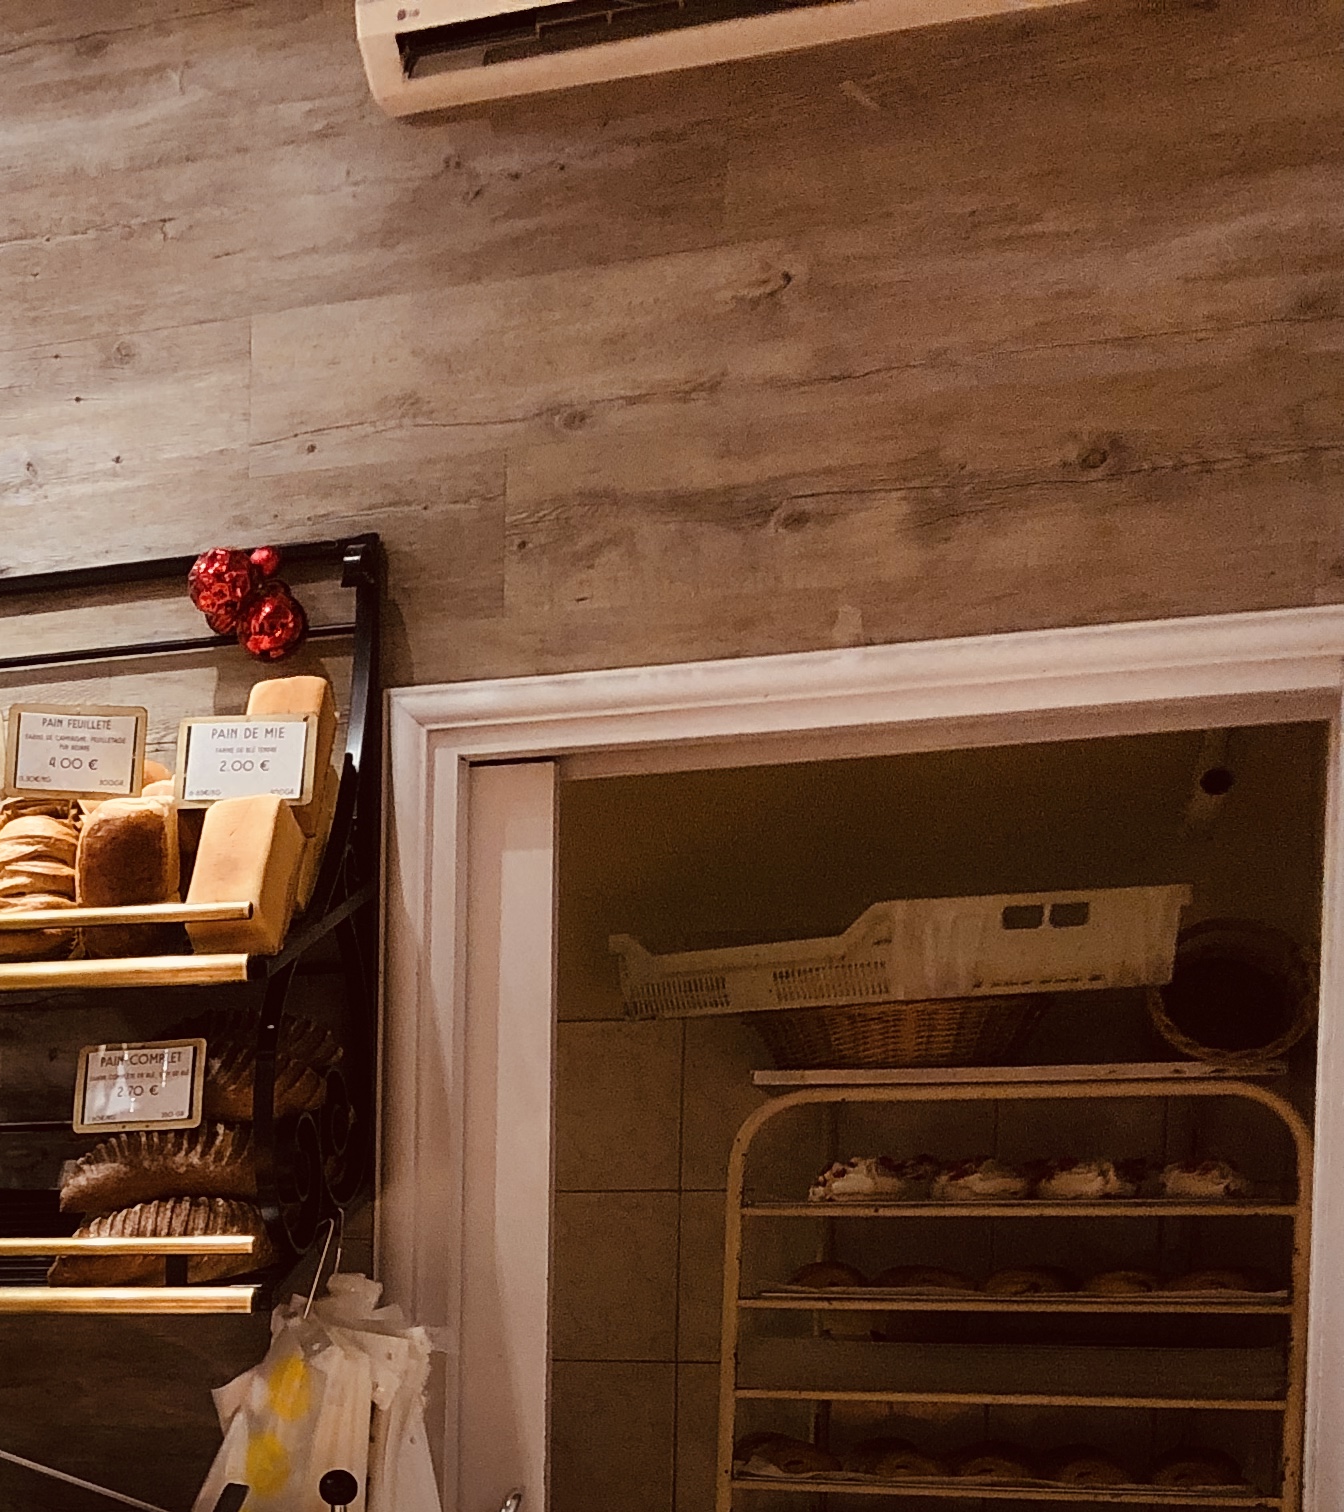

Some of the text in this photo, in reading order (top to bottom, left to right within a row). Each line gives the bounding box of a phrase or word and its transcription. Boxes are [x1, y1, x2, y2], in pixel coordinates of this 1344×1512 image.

[42, 718, 111, 730] PAIN FEUILLETÉ
[211, 727, 285, 739] PAIN DE MIE
[89, 759, 98, 770] €
[260, 760, 270, 771] €
[100, 1052, 182, 1067] PAIN COMPLET
[150, 1085, 159, 1095] €
